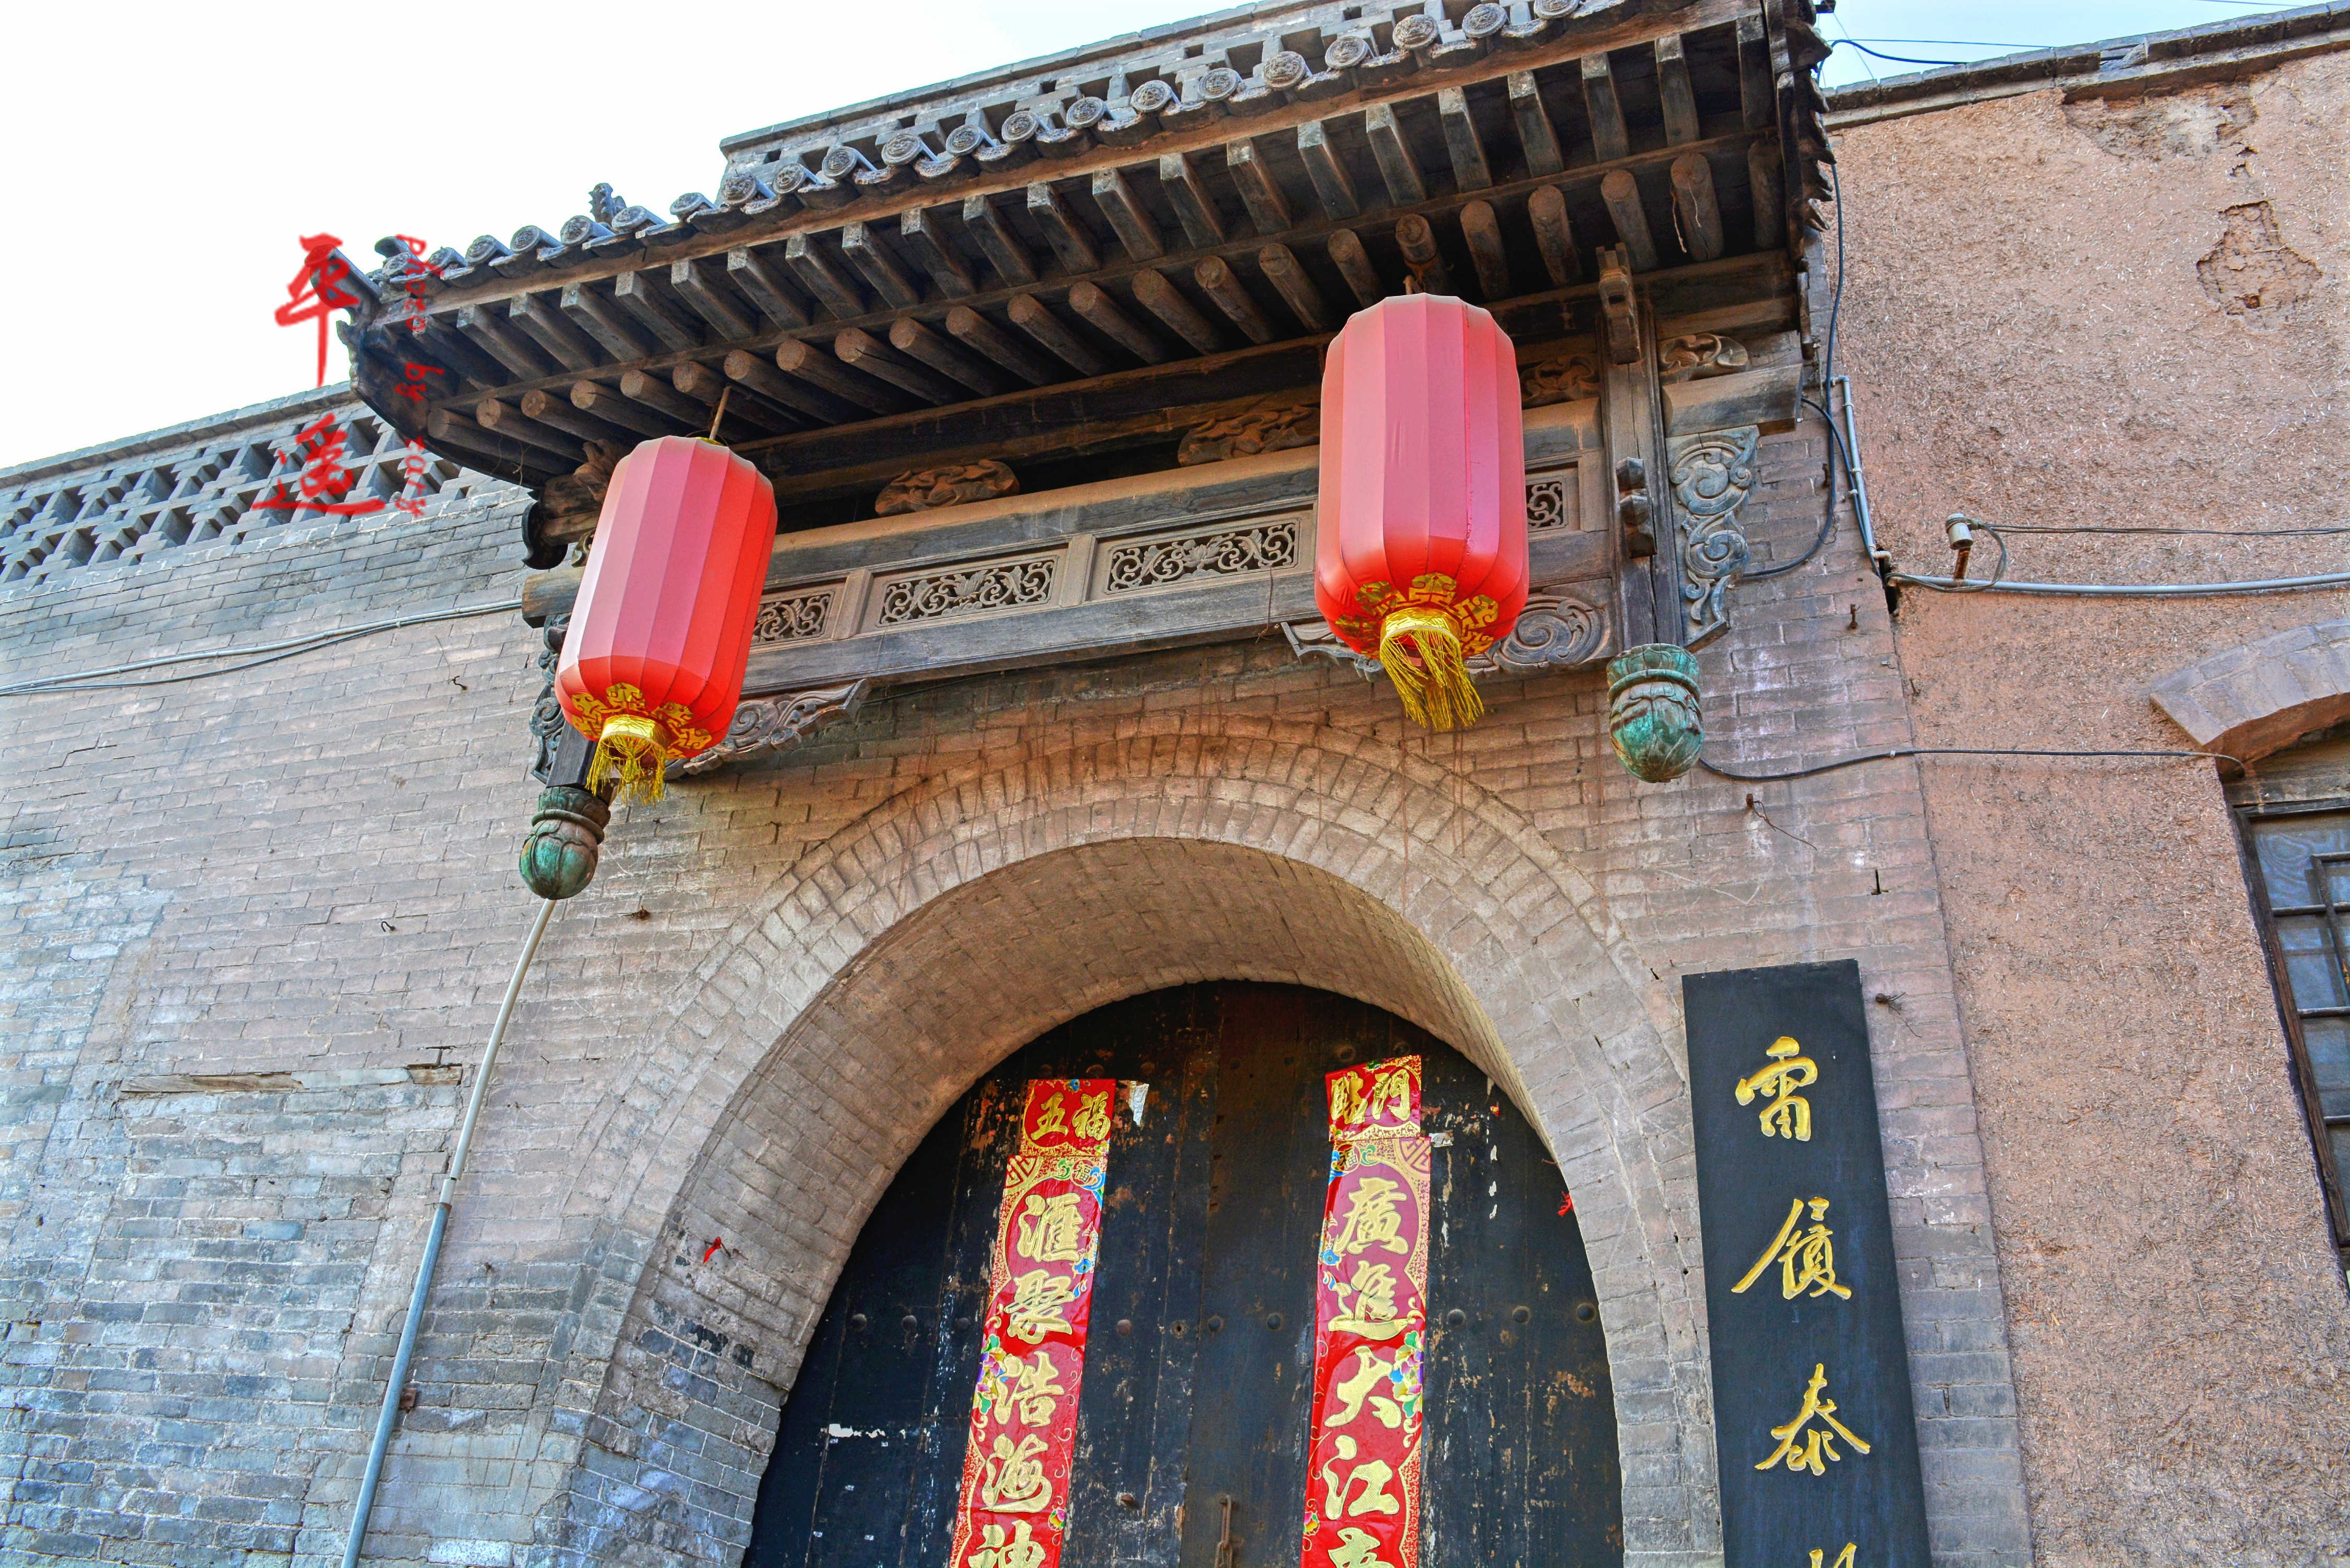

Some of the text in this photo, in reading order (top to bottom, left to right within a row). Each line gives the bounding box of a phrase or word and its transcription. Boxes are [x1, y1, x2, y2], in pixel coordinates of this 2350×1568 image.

[1030, 1091, 1111, 1141] 五福
[1073, 1161, 1092, 1182] 福
[1731, 1036, 1871, 1568] 雷履泰
